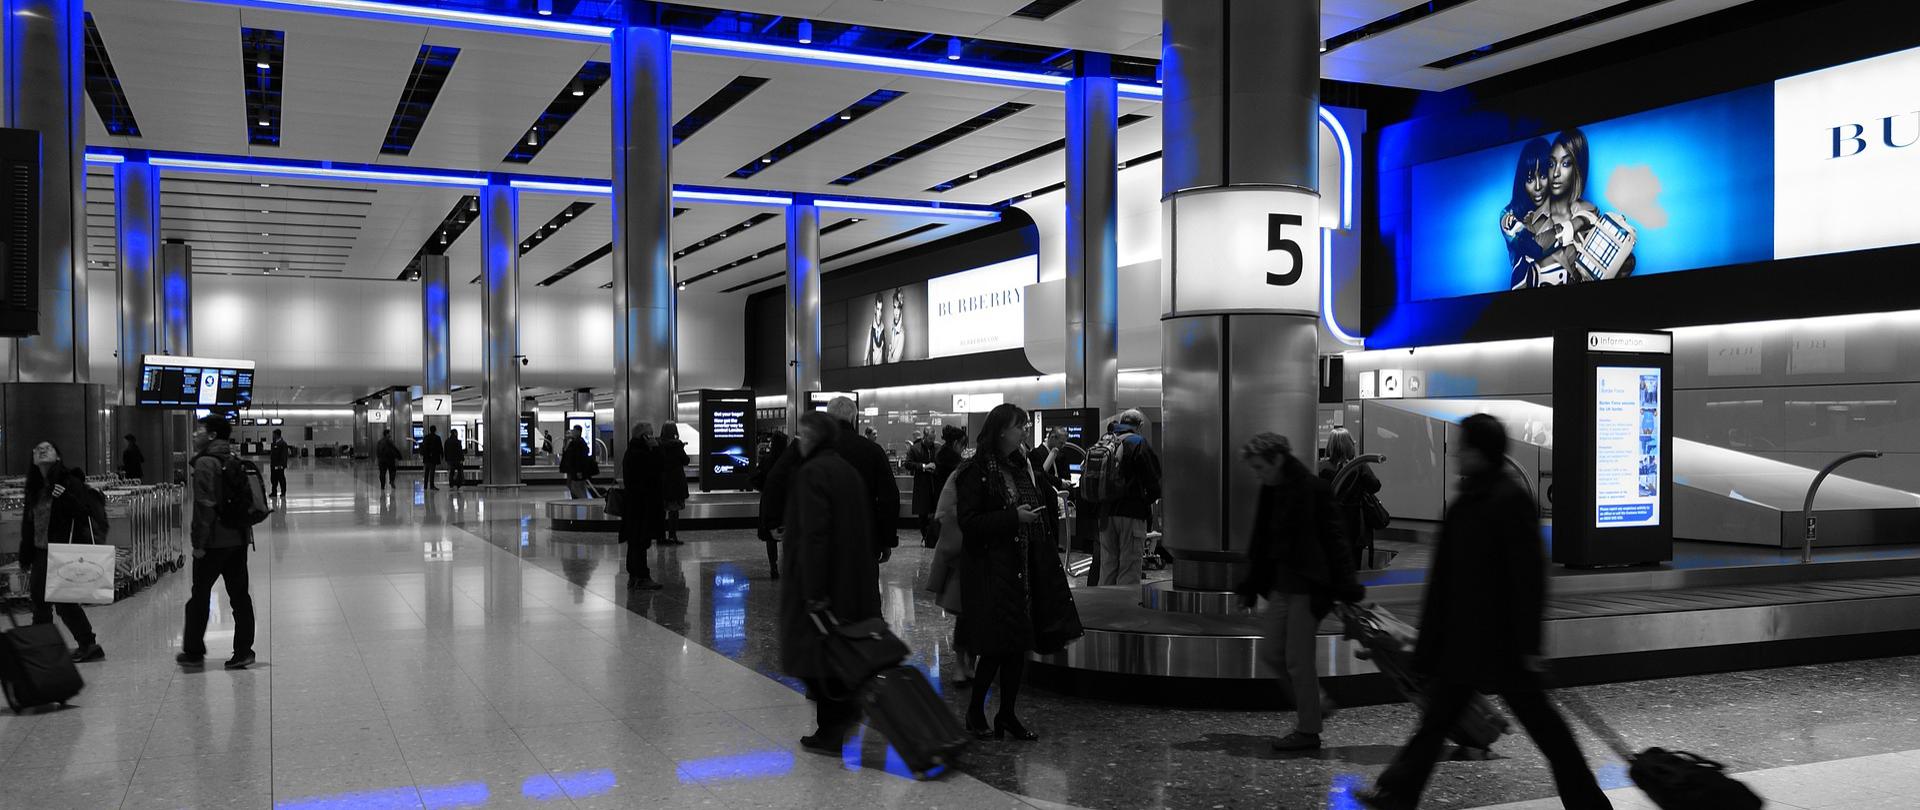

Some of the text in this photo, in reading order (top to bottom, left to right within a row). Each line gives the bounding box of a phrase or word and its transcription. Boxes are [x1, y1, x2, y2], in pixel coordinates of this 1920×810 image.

[1824, 110, 1920, 160] BU
[1266, 213, 1303, 286] 5
[938, 287, 1021, 317] BURBERRY
[1600, 337, 1643, 347] Information
[434, 399, 443, 411] 7
[375, 412, 382, 420] 9
